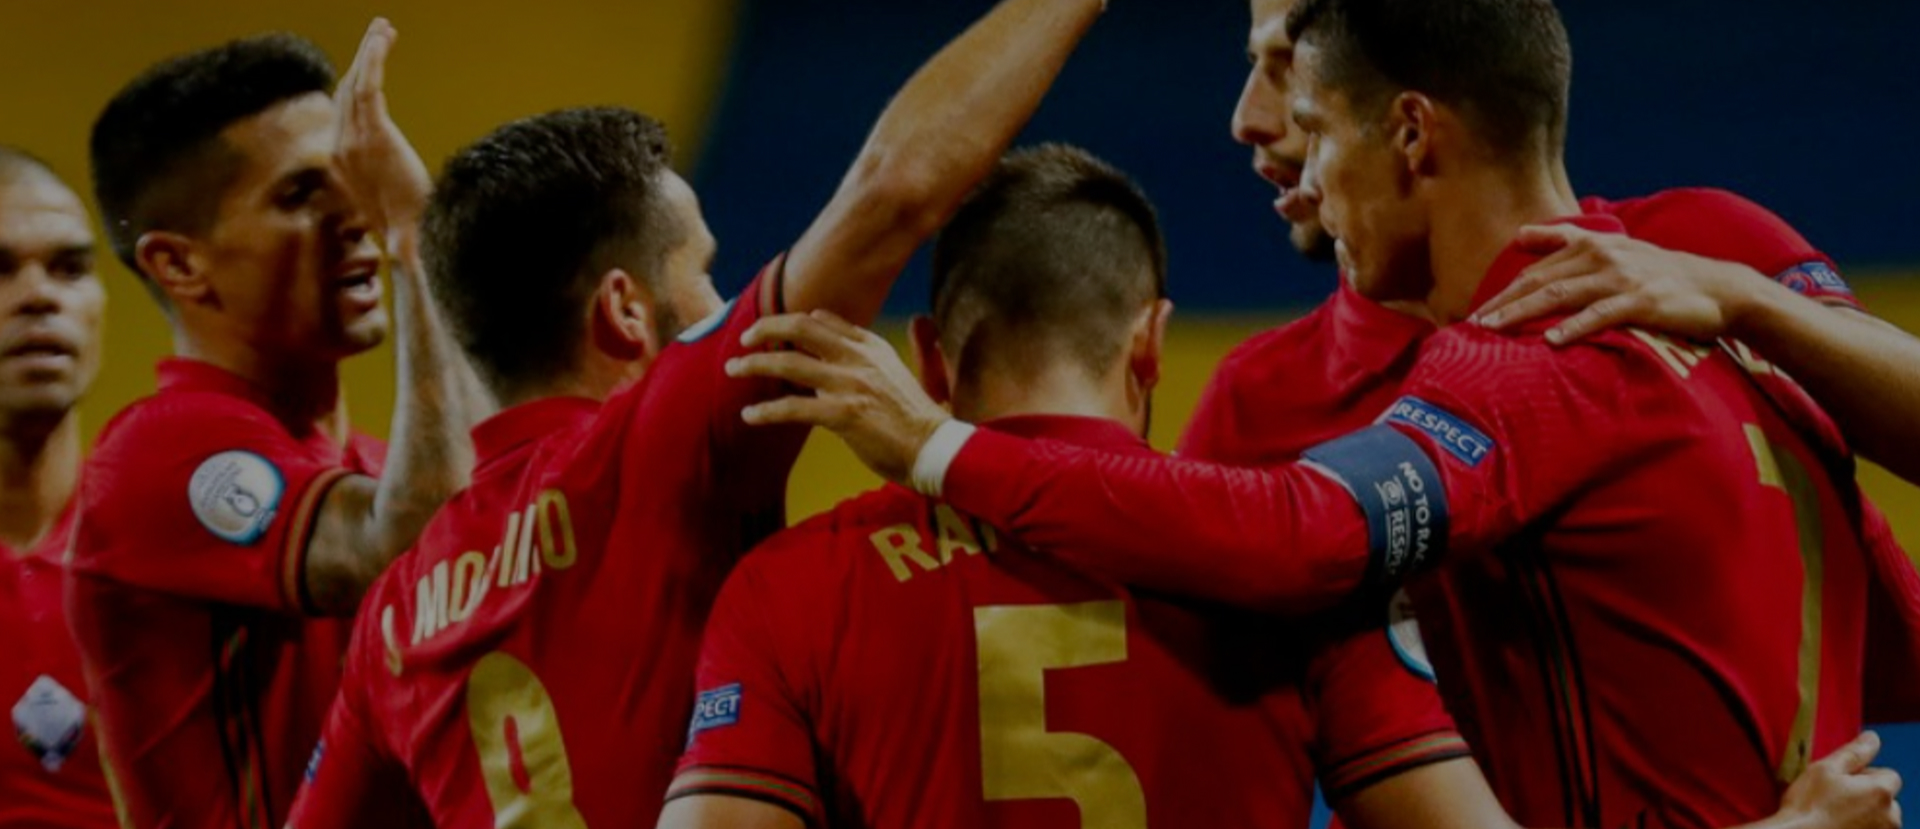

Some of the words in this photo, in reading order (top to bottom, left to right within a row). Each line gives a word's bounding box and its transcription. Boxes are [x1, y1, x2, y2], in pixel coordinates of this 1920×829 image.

[1396, 401, 1487, 459] RESPECT
[1399, 461, 1424, 493] NO
[1414, 493, 1431, 525] TO
[973, 600, 1149, 829] 5
